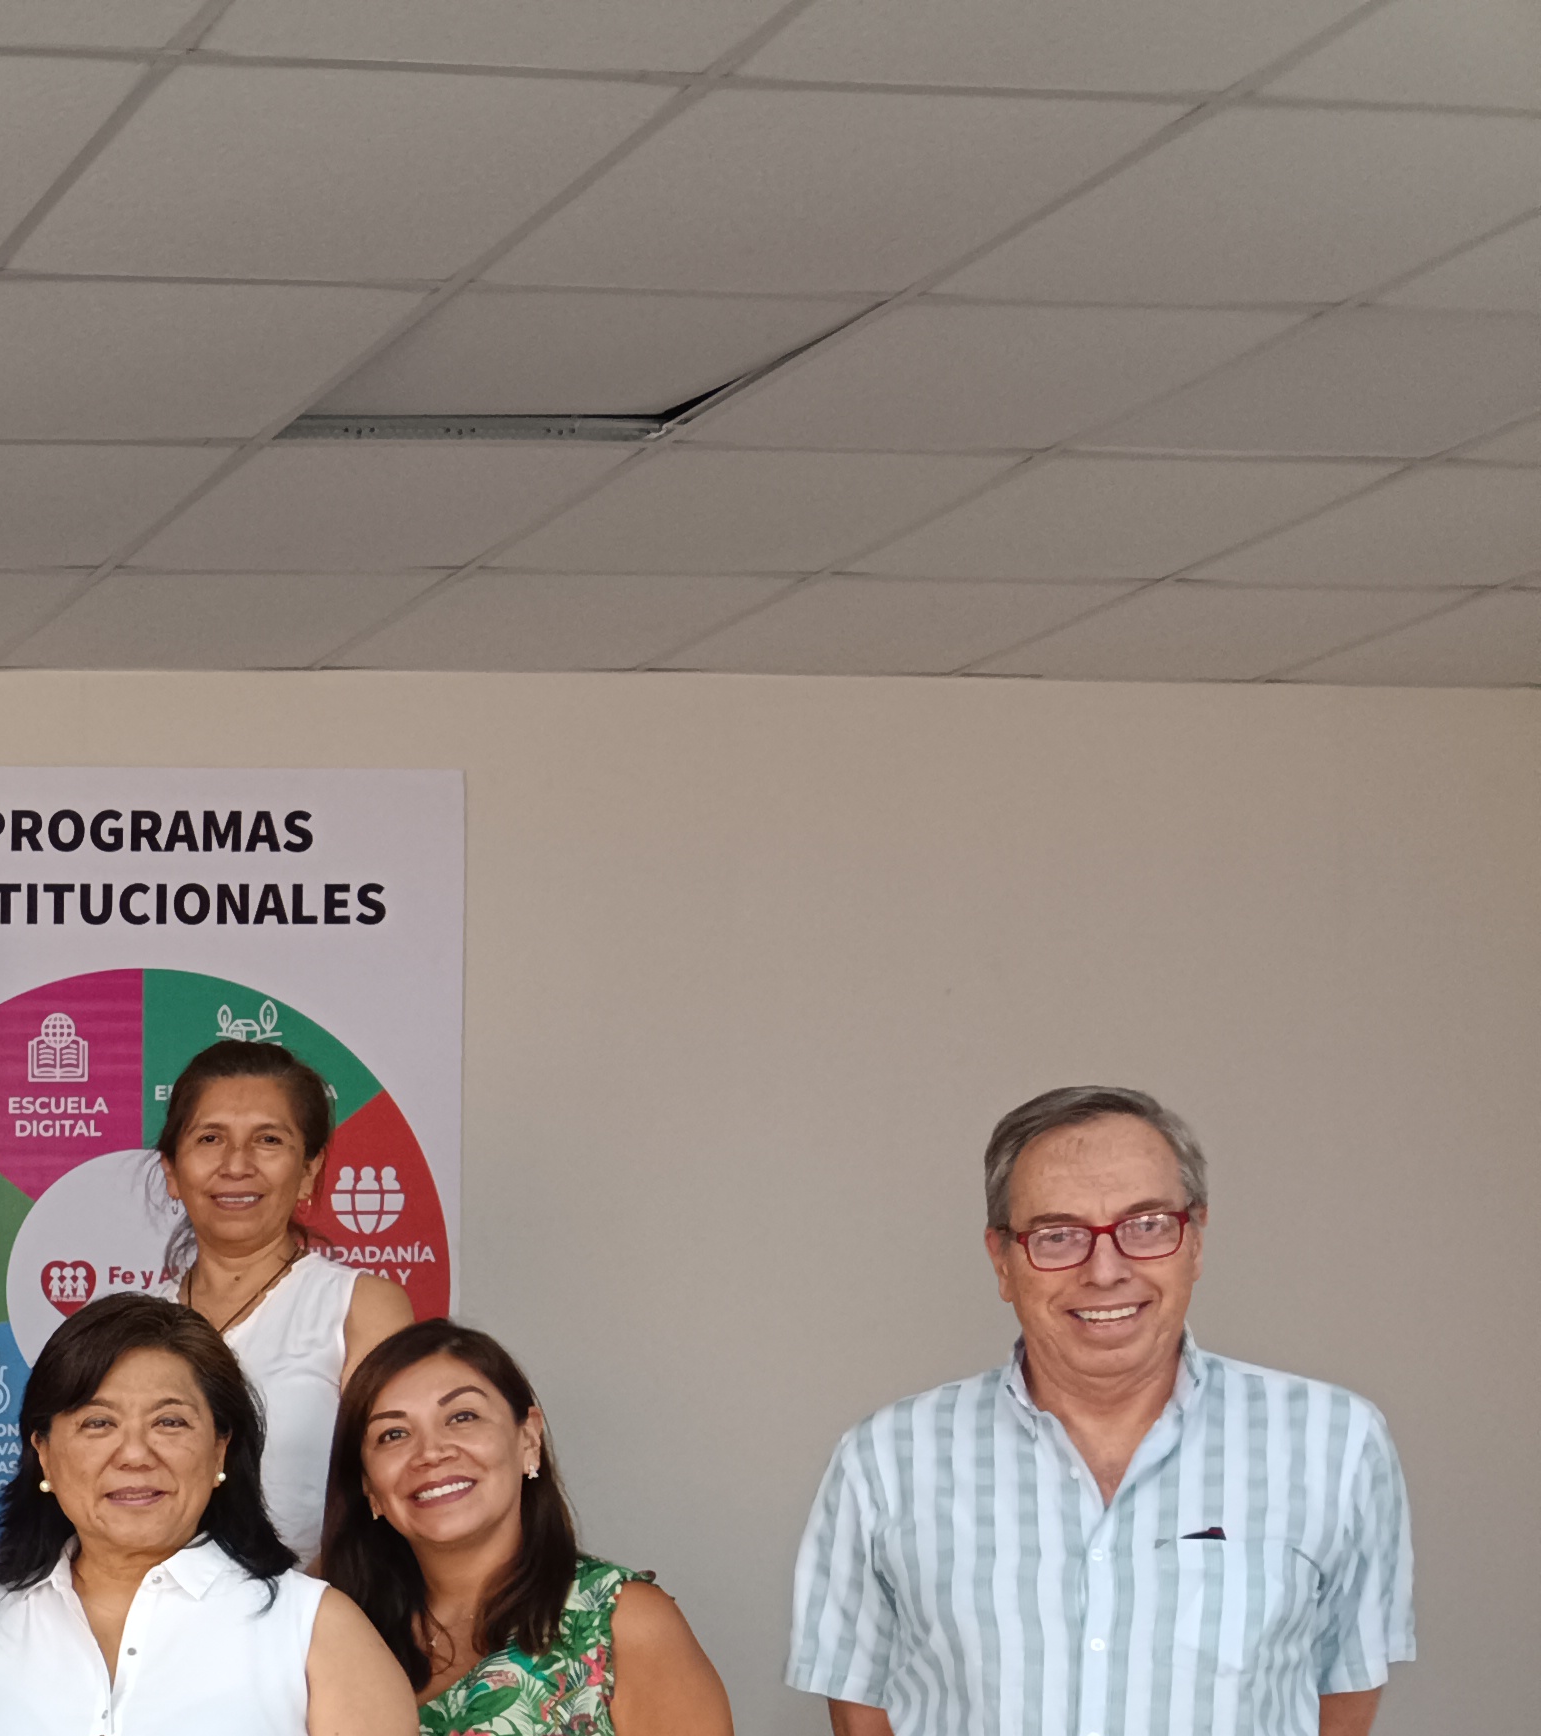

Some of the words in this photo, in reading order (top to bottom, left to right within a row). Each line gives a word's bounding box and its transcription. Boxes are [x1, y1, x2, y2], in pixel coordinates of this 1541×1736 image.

[8, 1096, 109, 1114] ESCUELA
[15, 1120, 103, 1137] DIGITAL
[108, 1266, 135, 1285] Fe
[140, 1270, 154, 1290] y
[396, 1268, 412, 1286] Y
